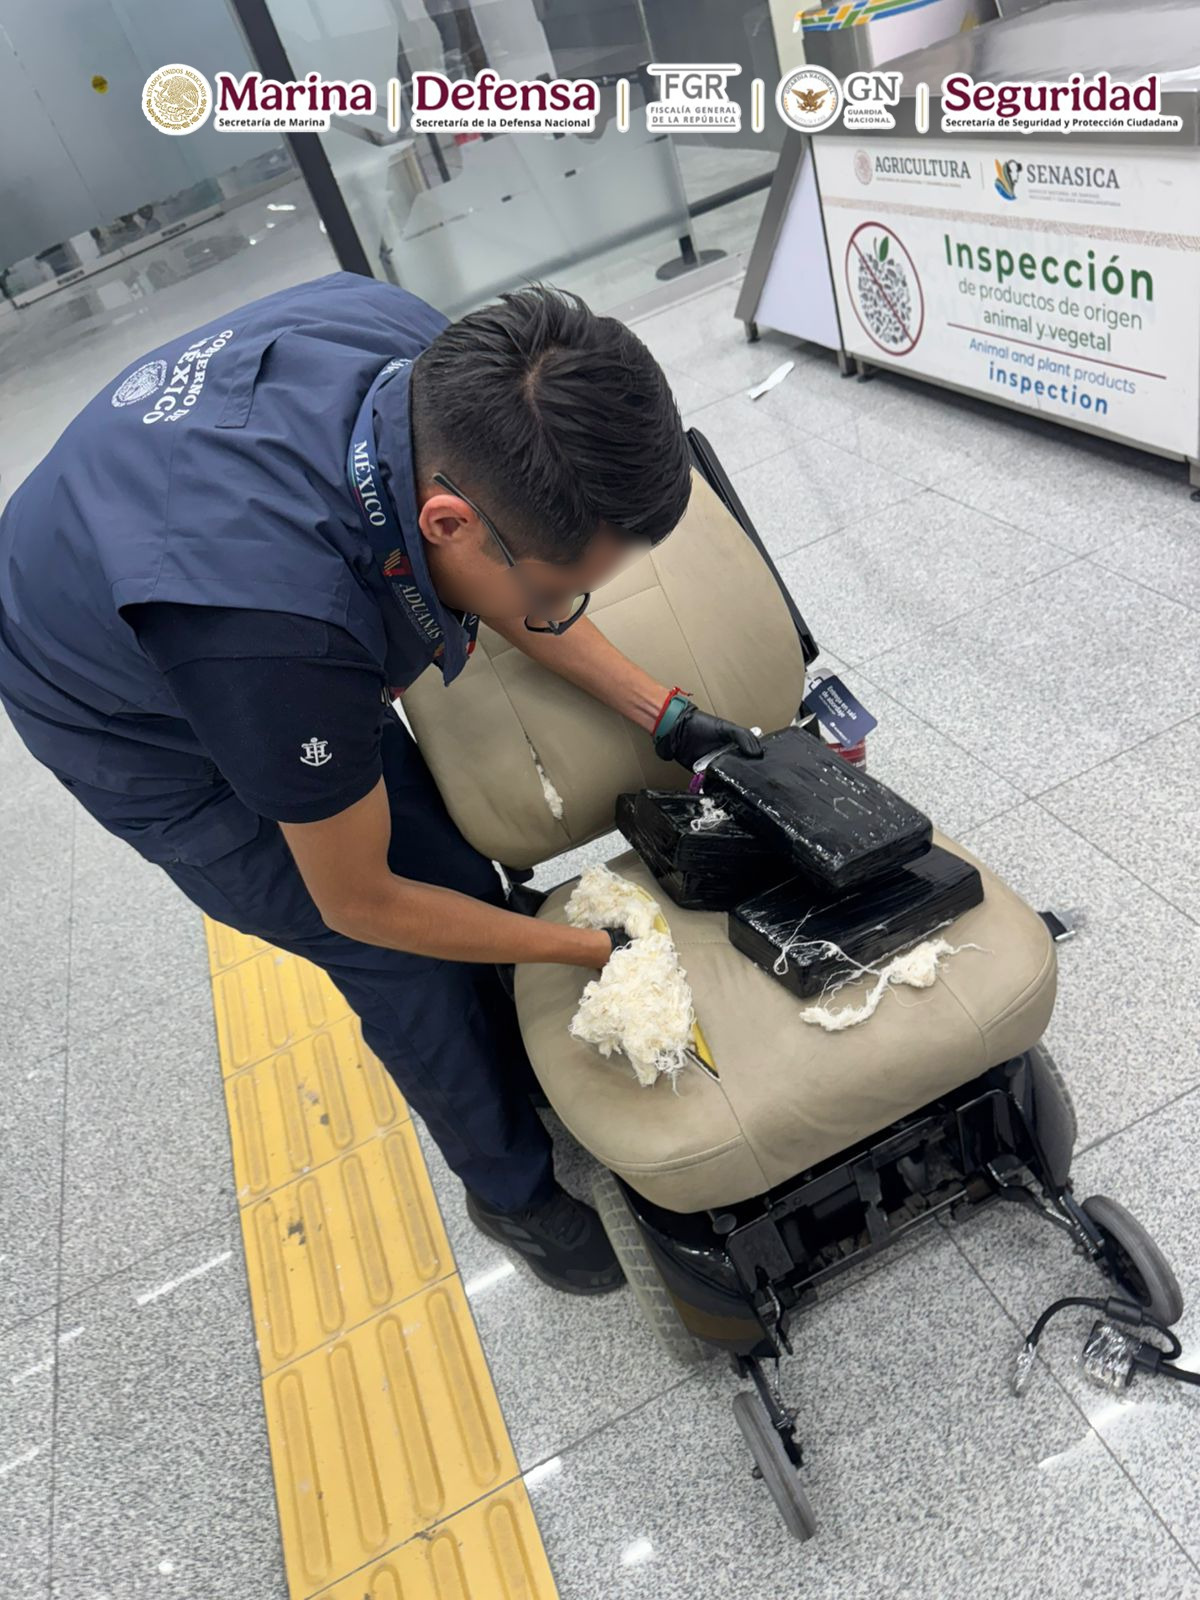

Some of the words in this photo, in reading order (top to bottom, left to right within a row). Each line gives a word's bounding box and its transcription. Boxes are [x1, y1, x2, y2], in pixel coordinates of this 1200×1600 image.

[875, 156, 972, 180] AGRICULTURA
[1027, 164, 1120, 189] SENASICA
[944, 234, 1154, 302] Inspección
[958, 278, 976, 296] de
[979, 283, 1055, 313] productos
[1059, 296, 1080, 318] de
[1084, 303, 1143, 331] origen
[984, 309, 1032, 334] animal
[1036, 321, 1046, 340] y
[1048, 325, 1111, 352] vegetal
[969, 338, 1009, 359] Animal
[1012, 347, 1035, 367] and
[1038, 355, 1071, 377] plant
[1073, 366, 1137, 395] products
[988, 362, 1108, 415] inspection
[354, 439, 387, 527] MÉXICO
[399, 584, 444, 640] ADUANAS
